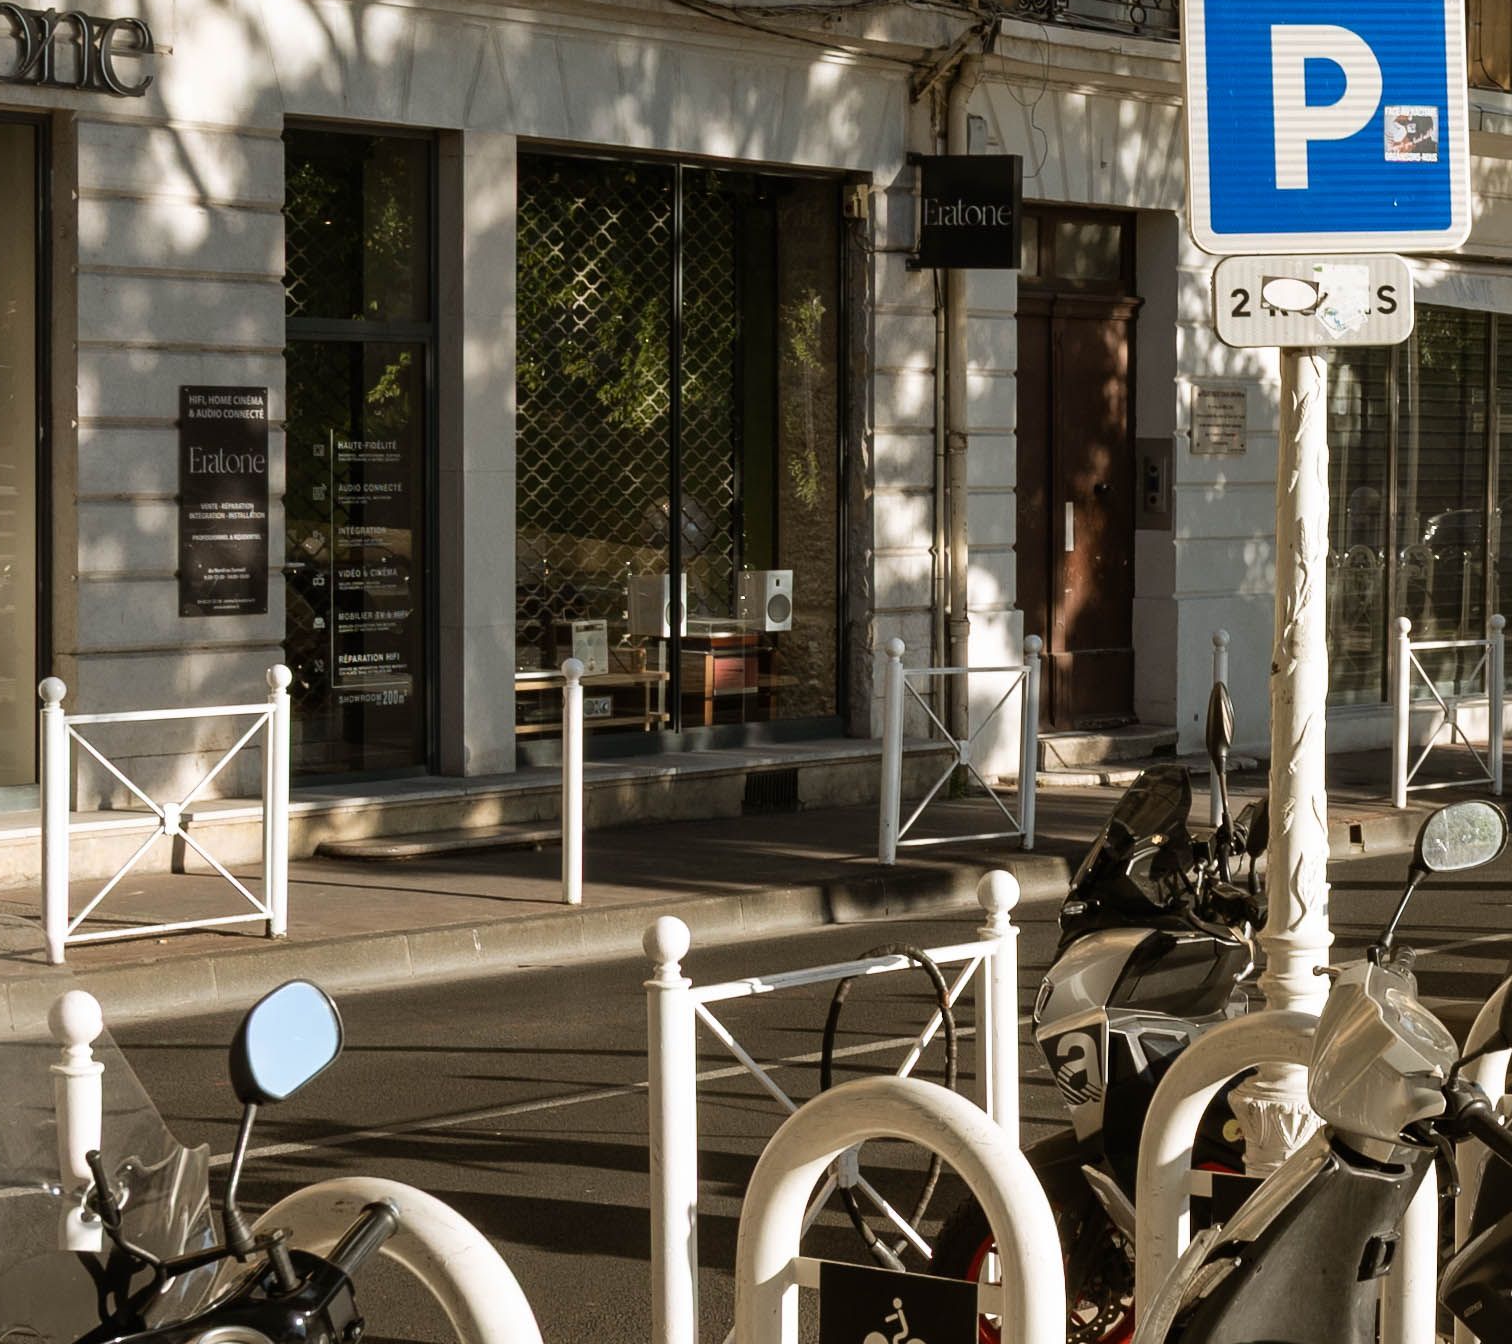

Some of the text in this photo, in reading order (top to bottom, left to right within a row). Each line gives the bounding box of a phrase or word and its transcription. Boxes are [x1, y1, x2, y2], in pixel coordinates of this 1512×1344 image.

[1270, 24, 1384, 190] P
[924, 198, 1012, 226] Eratone
[208, 395, 232, 405] HOME
[196, 408, 222, 419] AUDIO
[190, 447, 265, 474] Eratone
[338, 653, 384, 664] RÉPARATION
